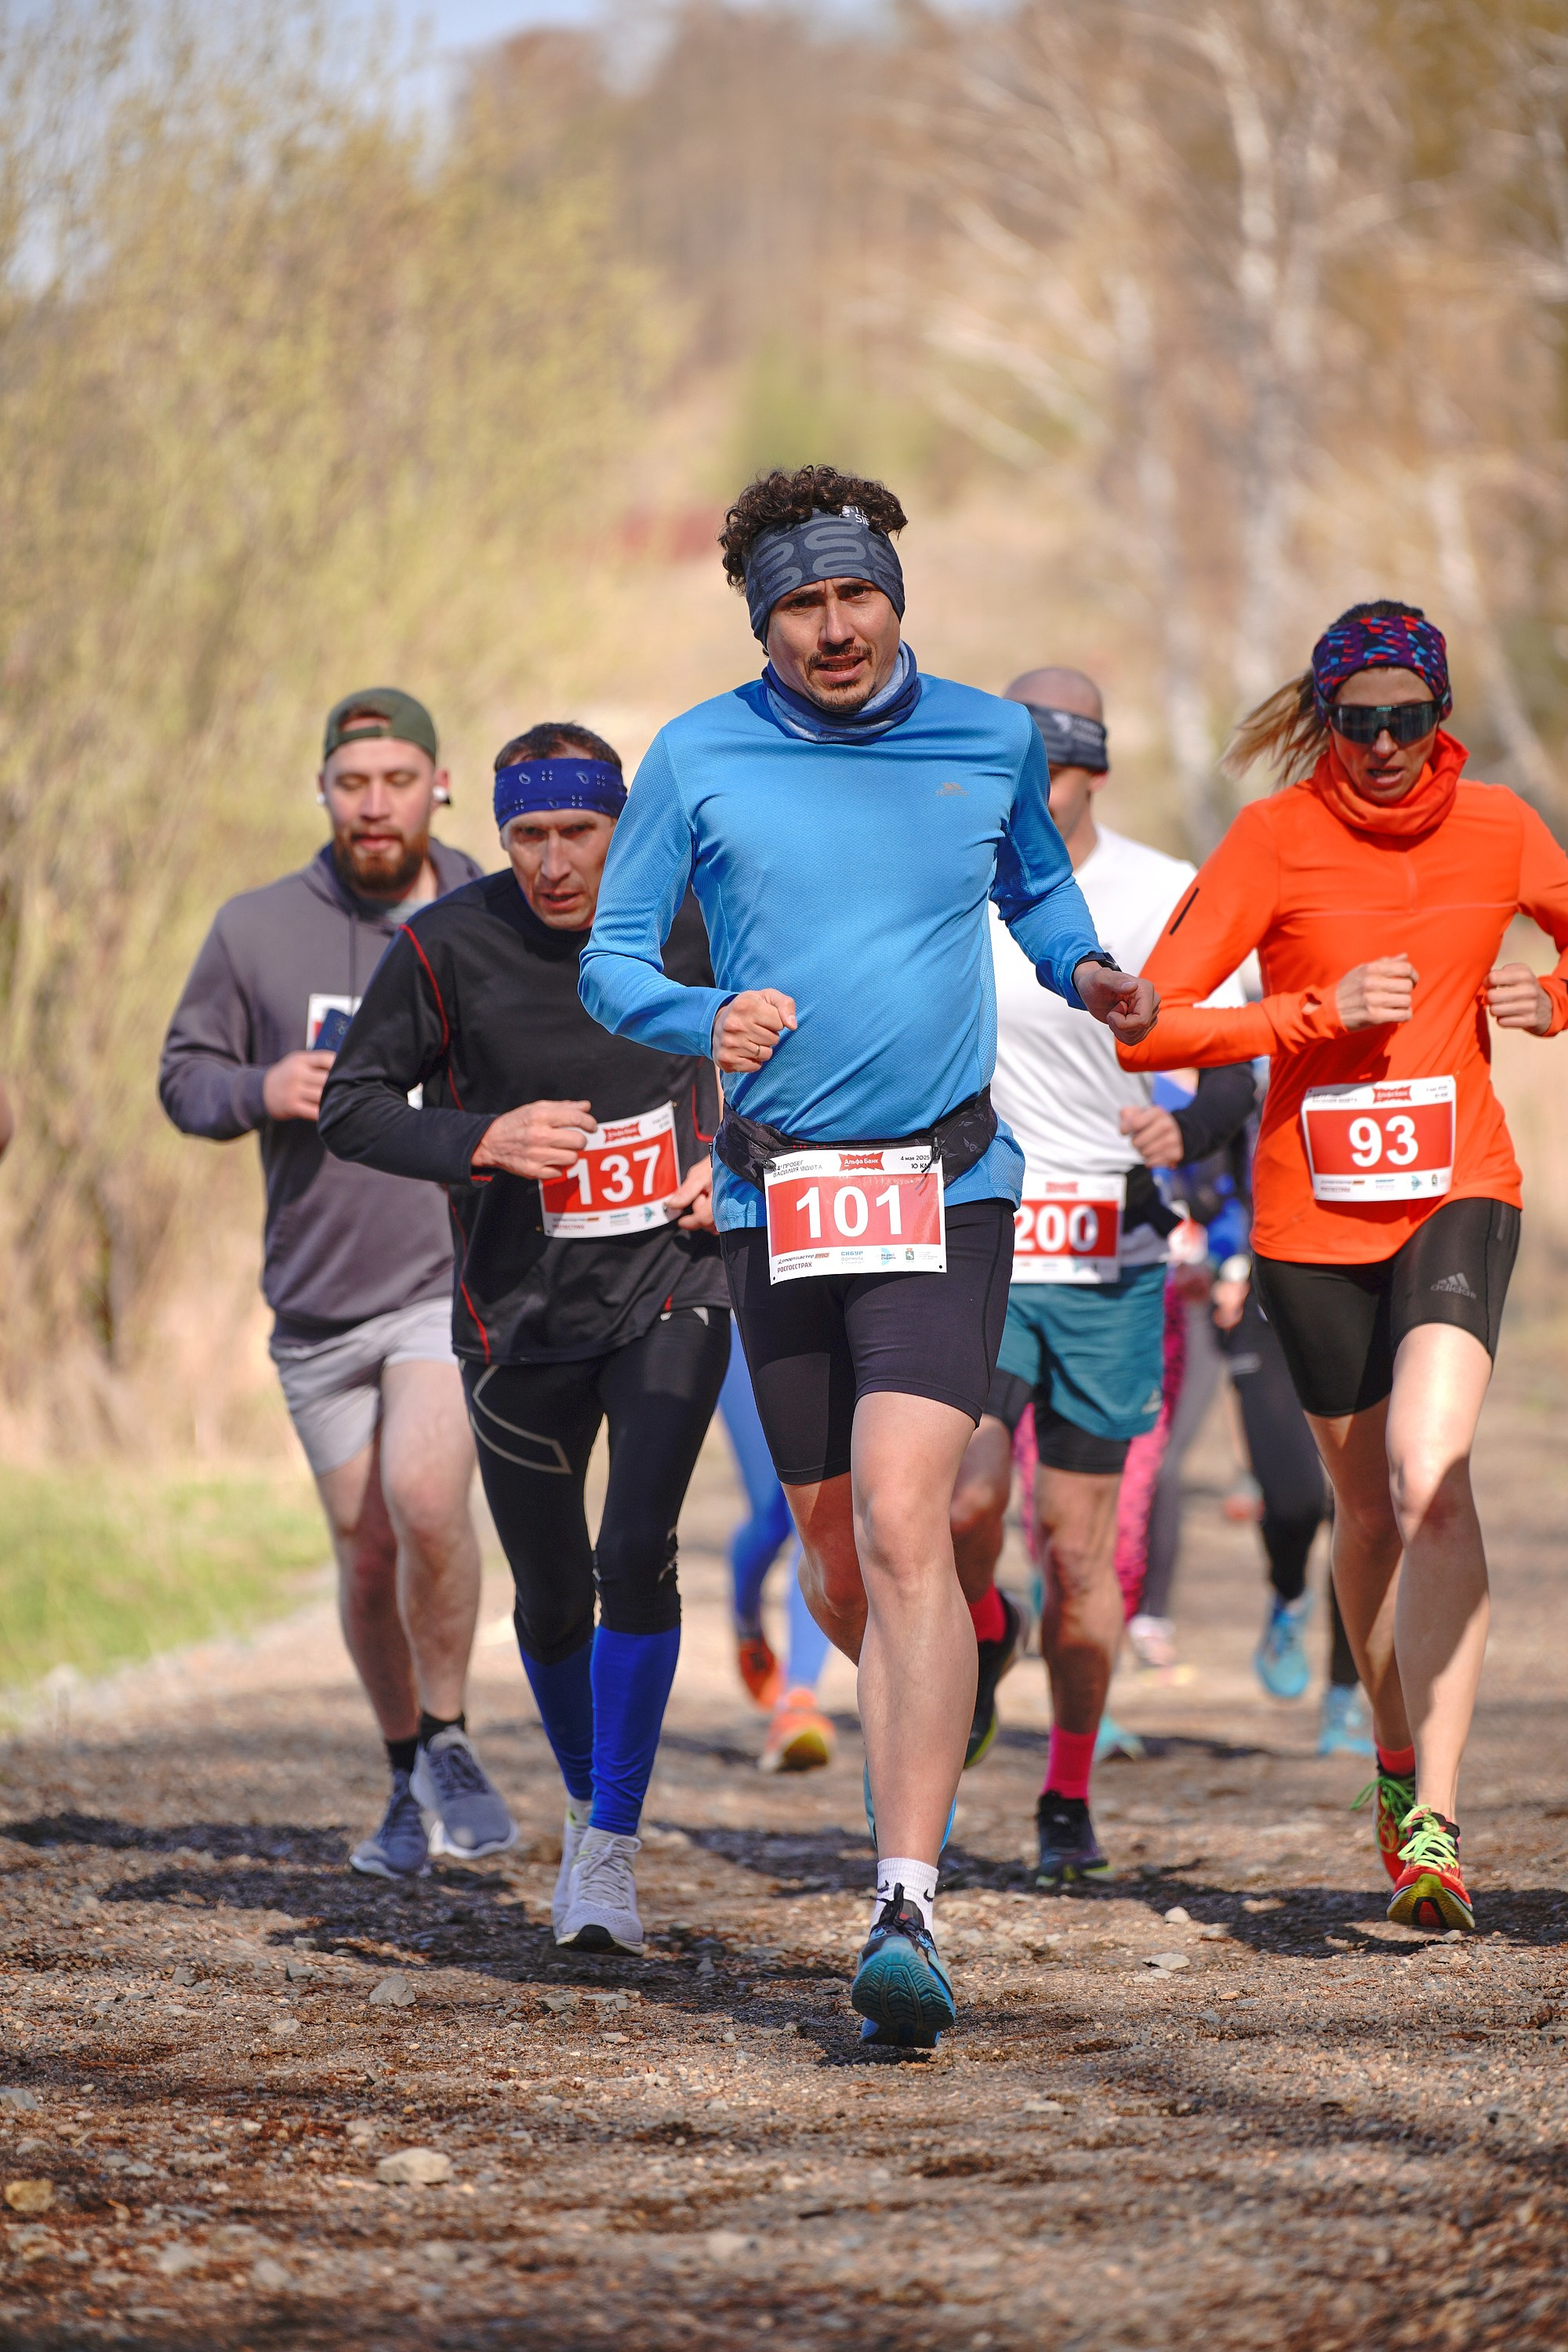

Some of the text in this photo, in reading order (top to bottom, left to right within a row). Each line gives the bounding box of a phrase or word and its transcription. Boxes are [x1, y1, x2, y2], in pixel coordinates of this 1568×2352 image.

[1348, 1114, 1419, 1167] 93
[565, 1144, 661, 1205] 137
[796, 1184, 902, 1239] 101
[1014, 1204, 1099, 1253] 200
[777, 1261, 812, 1273] РОСГОССТРАХ
